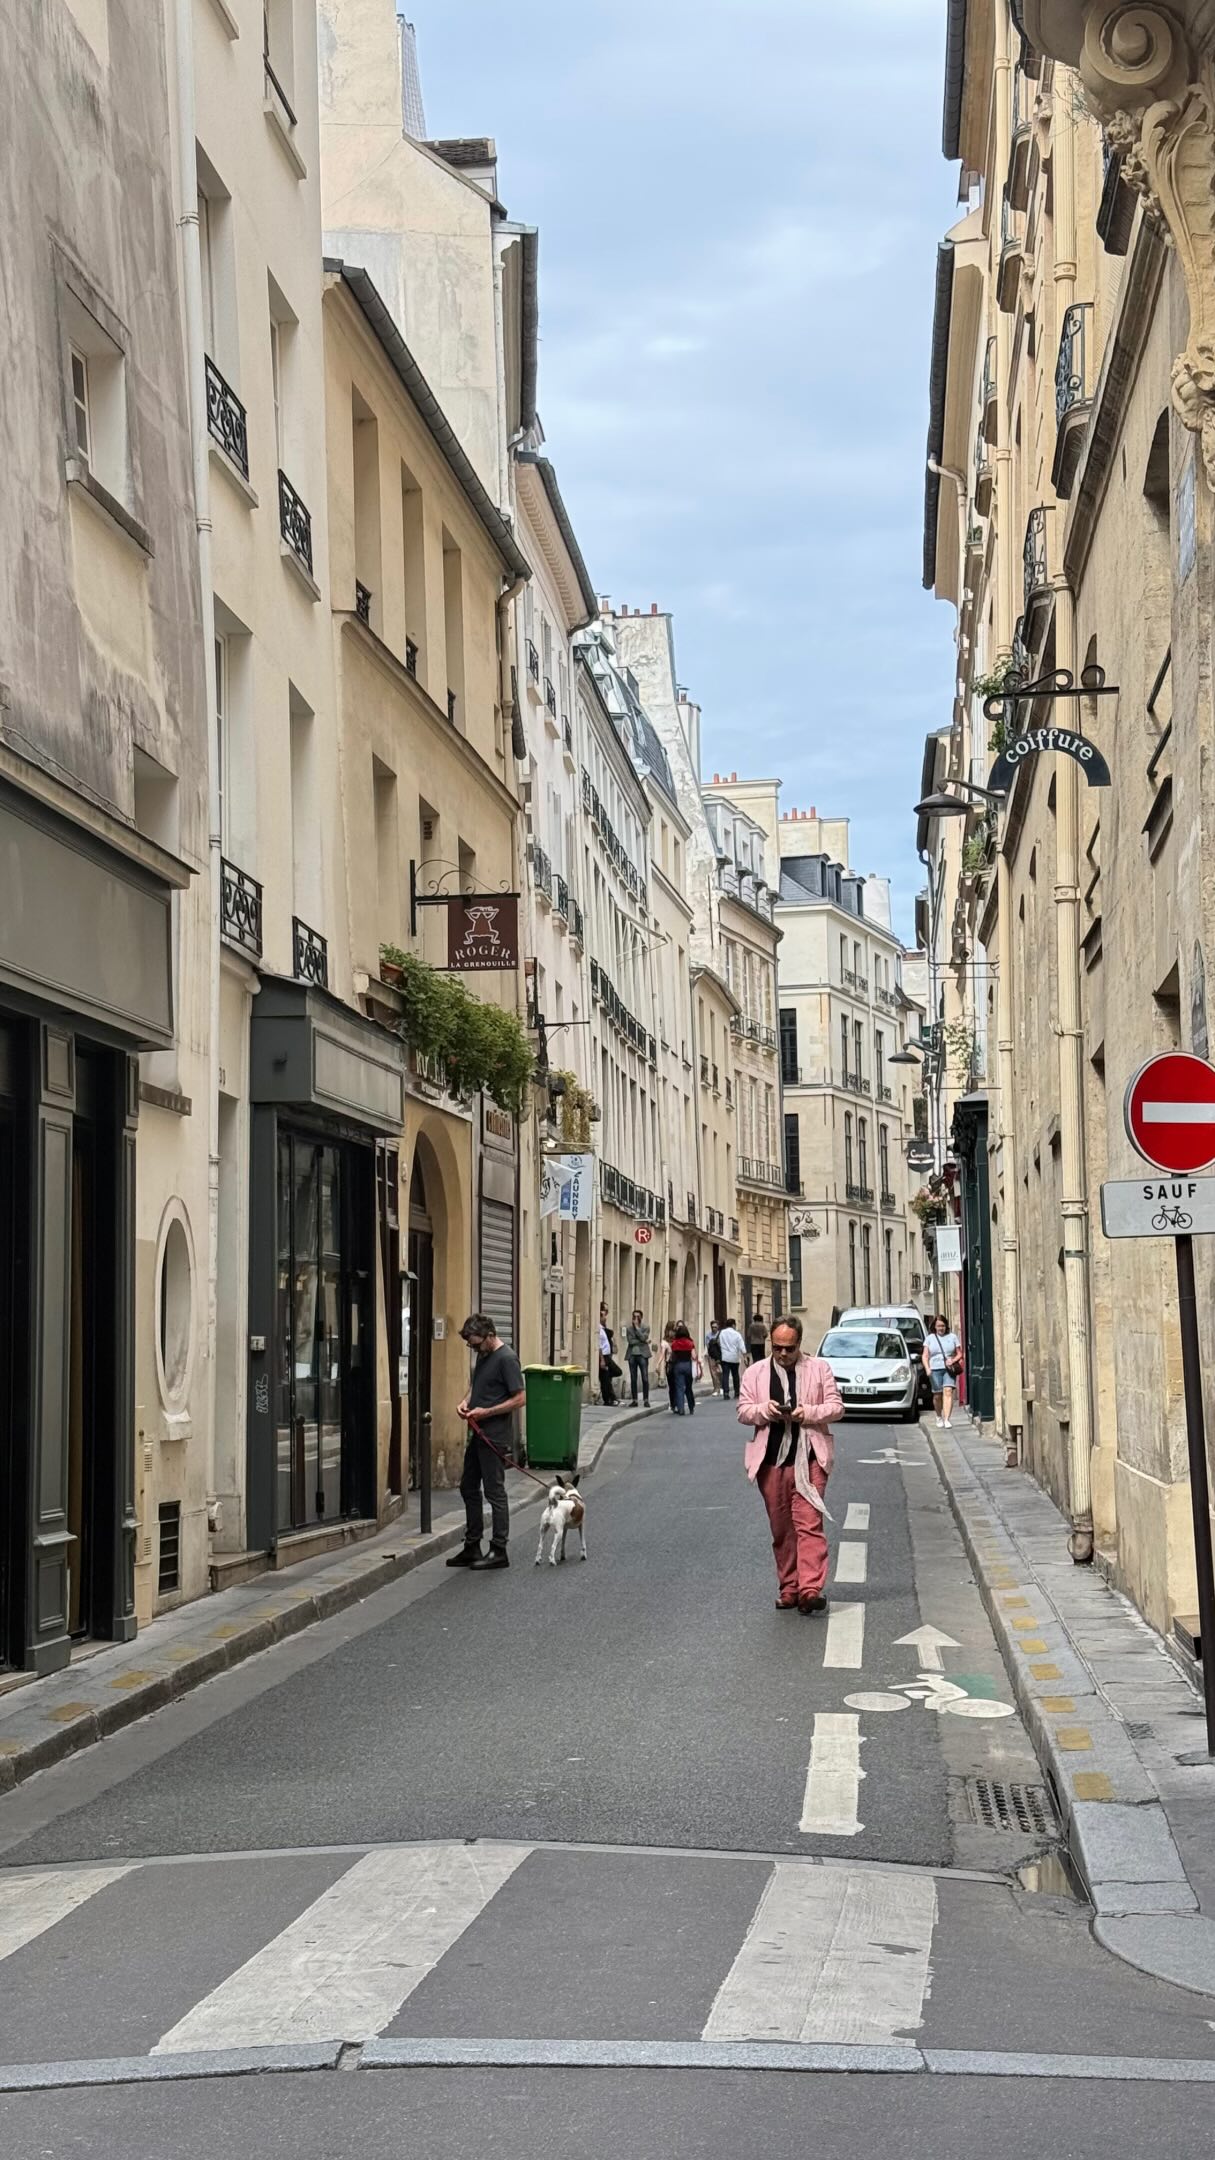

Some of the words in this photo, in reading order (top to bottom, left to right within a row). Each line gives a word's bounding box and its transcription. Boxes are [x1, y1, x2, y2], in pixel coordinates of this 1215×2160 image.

[1006, 729, 1093, 763] coiffure
[455, 945, 511, 960] ROGER
[463, 960, 516, 968] GRENOUILLE
[1143, 1183, 1197, 1200] SAUF
